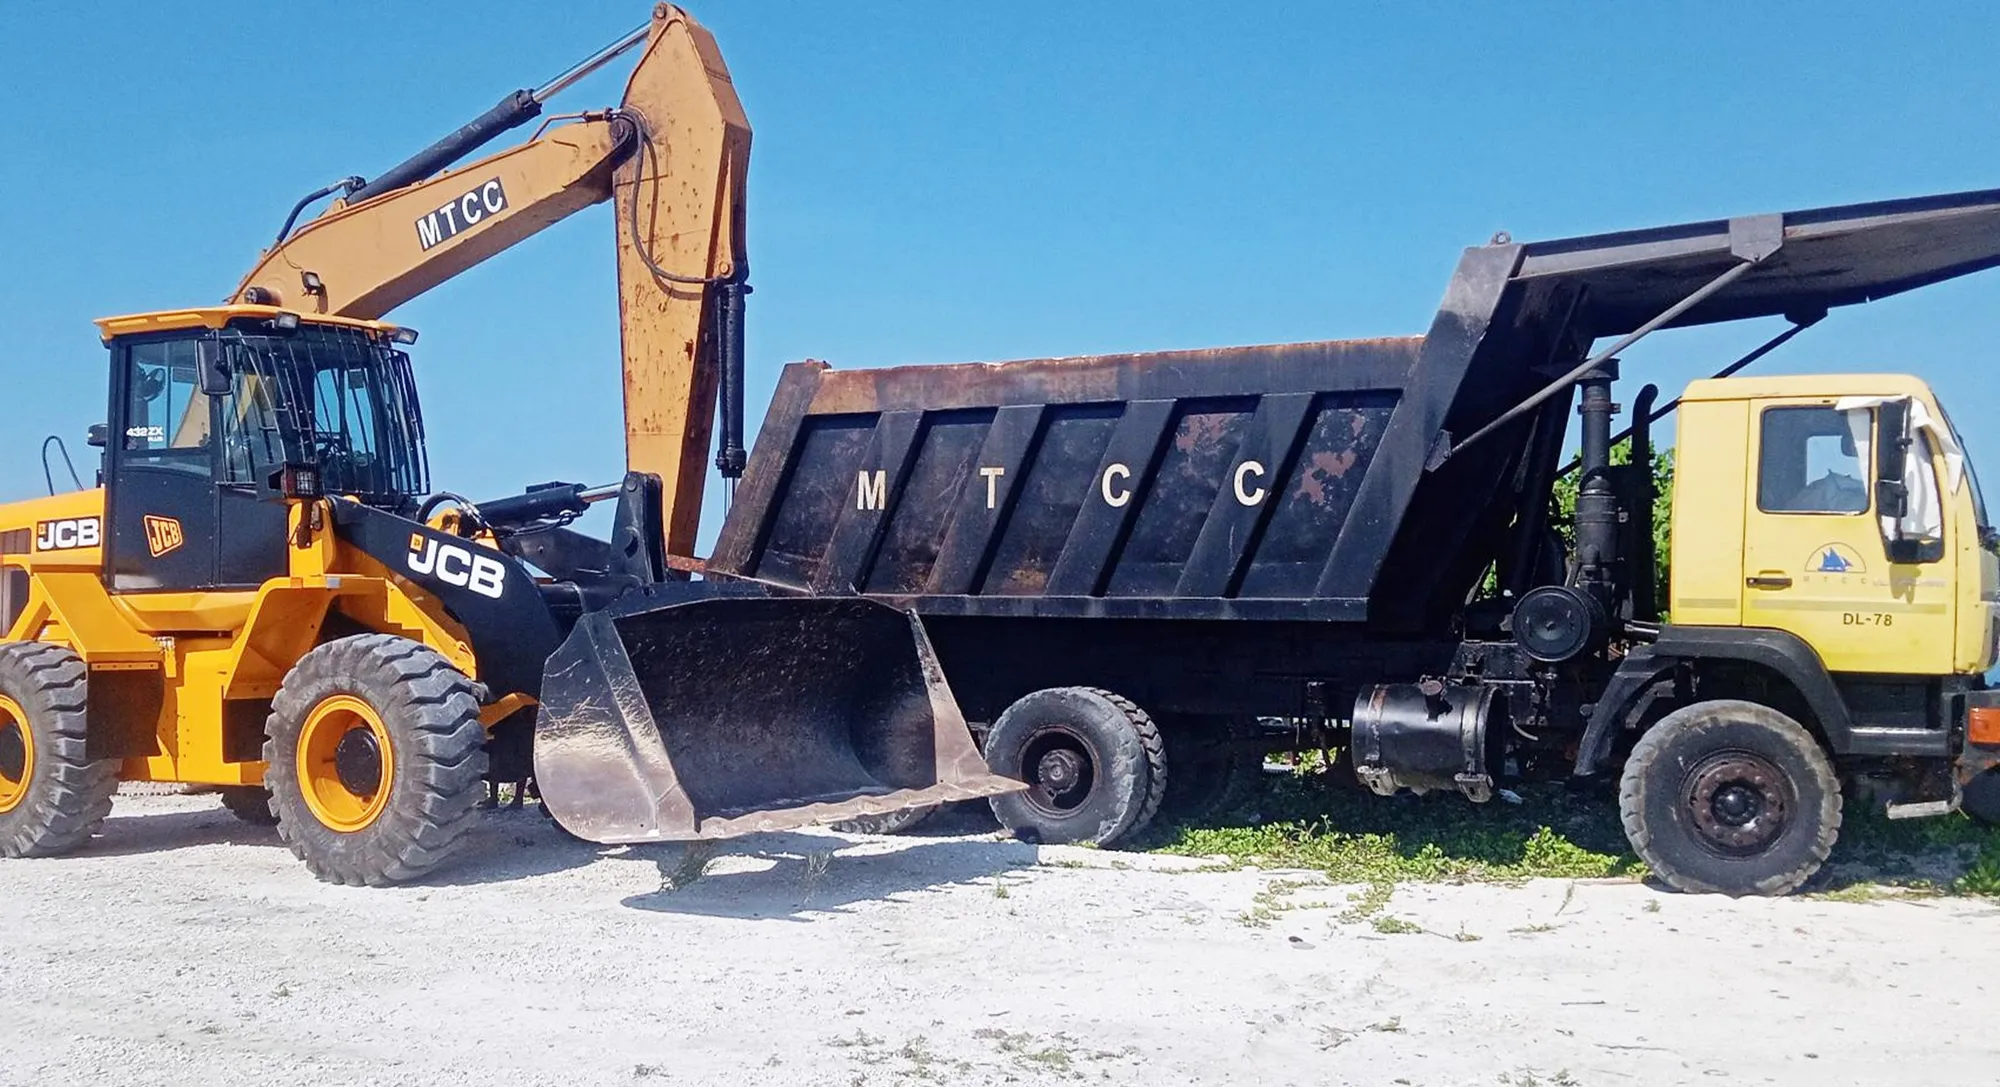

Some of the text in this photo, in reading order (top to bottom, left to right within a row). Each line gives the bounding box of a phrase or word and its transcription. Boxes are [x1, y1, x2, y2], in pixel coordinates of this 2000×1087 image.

[416, 181, 503, 249] MTCC
[37, 518, 100, 550] JCB
[151, 519, 179, 552] JCB
[407, 538, 506, 599] JCB
[1843, 613, 1893, 627] DL-78
